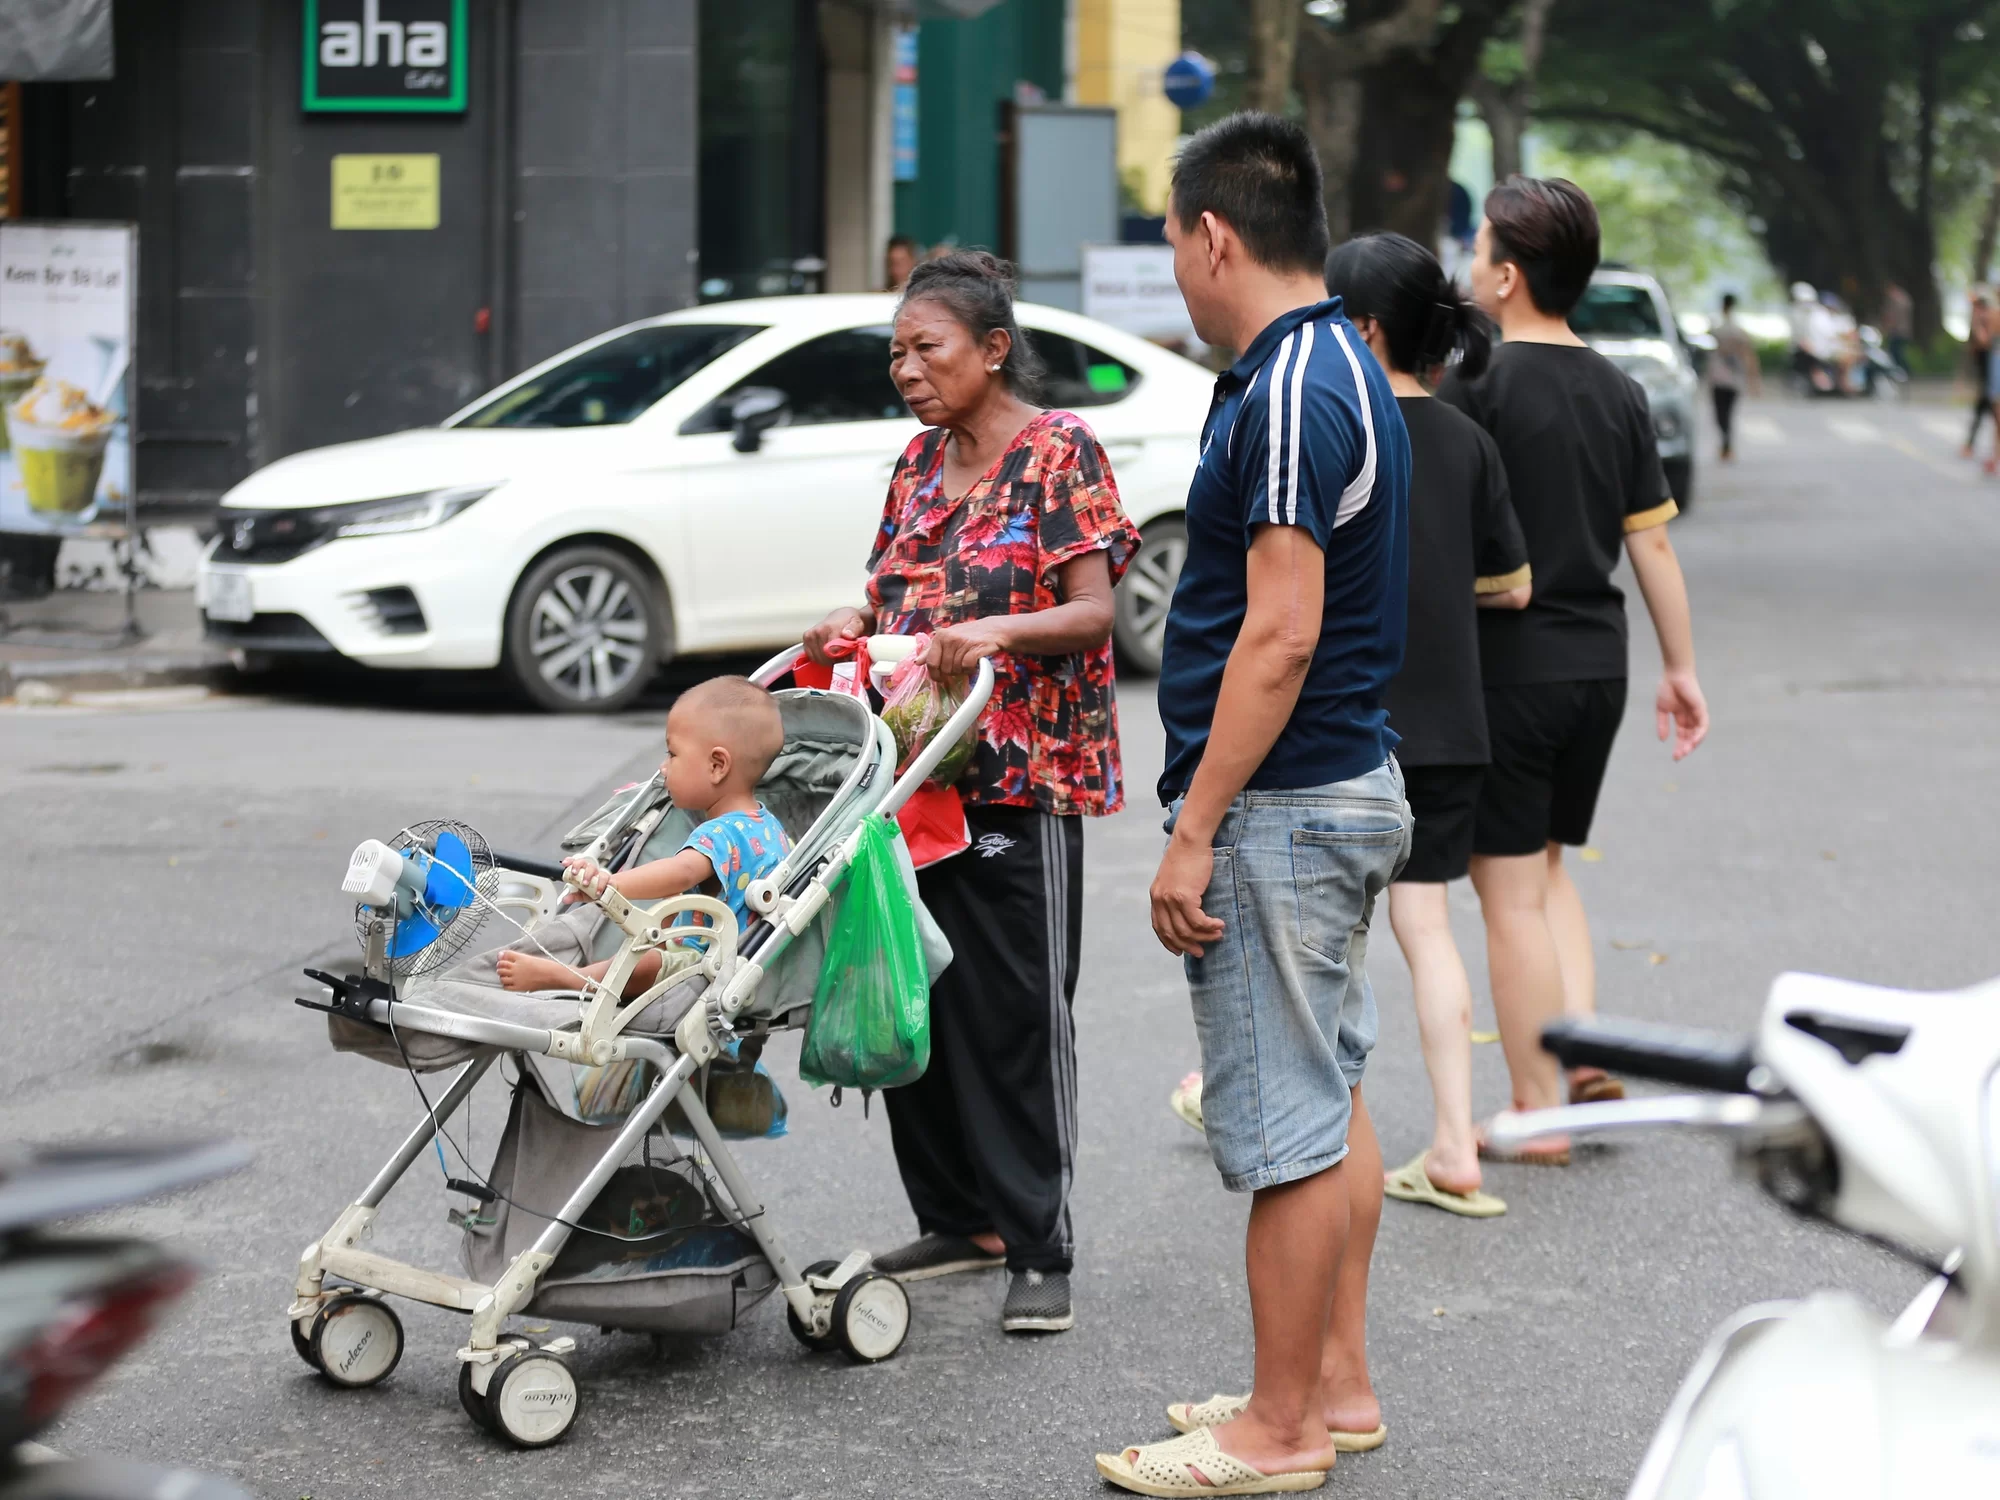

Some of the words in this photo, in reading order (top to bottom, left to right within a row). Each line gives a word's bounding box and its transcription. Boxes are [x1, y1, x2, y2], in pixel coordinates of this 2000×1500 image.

[320, 0, 448, 67] aha
[339, 1329, 373, 1374] belecoo
[523, 1392, 574, 1406] belecoo
